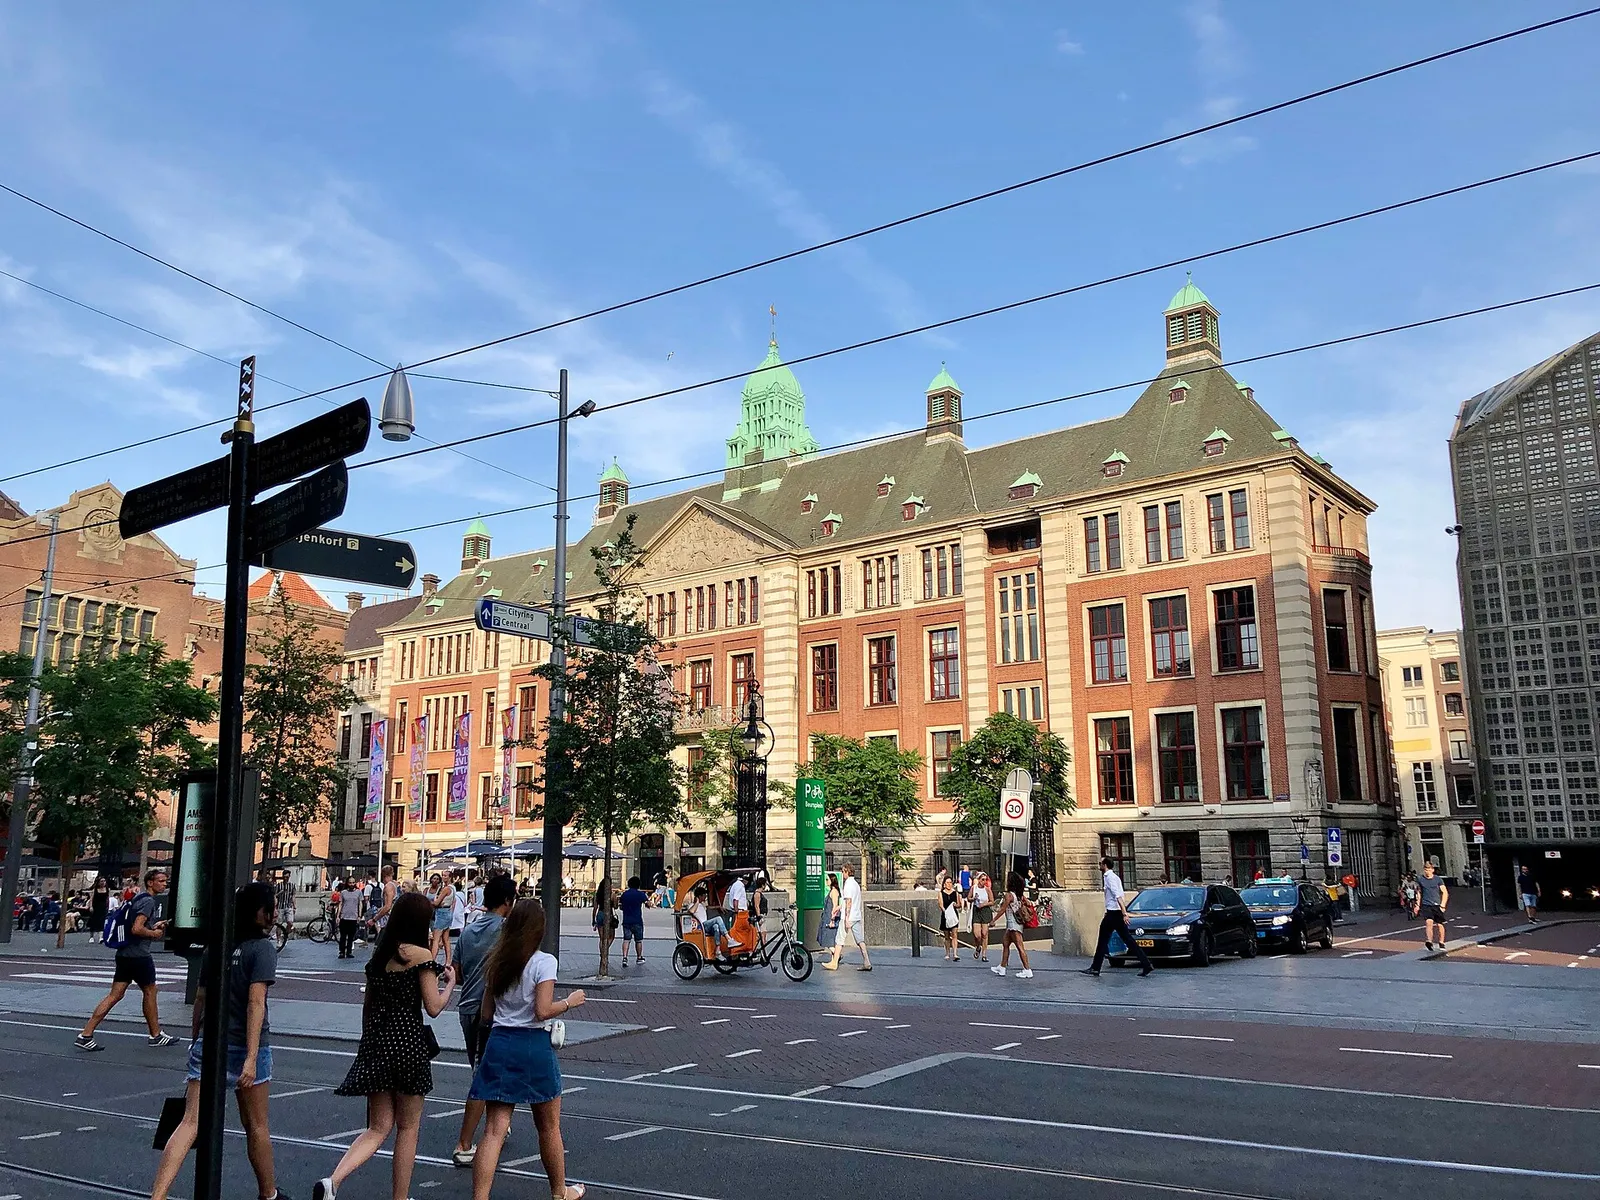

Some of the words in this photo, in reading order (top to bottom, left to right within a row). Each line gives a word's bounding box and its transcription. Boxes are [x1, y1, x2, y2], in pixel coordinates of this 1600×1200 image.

[295, 533, 343, 547] jenkorf
[508, 607, 535, 622] Cityring
[501, 618, 530, 631] Centraal
[1008, 804, 1021, 813] 30
